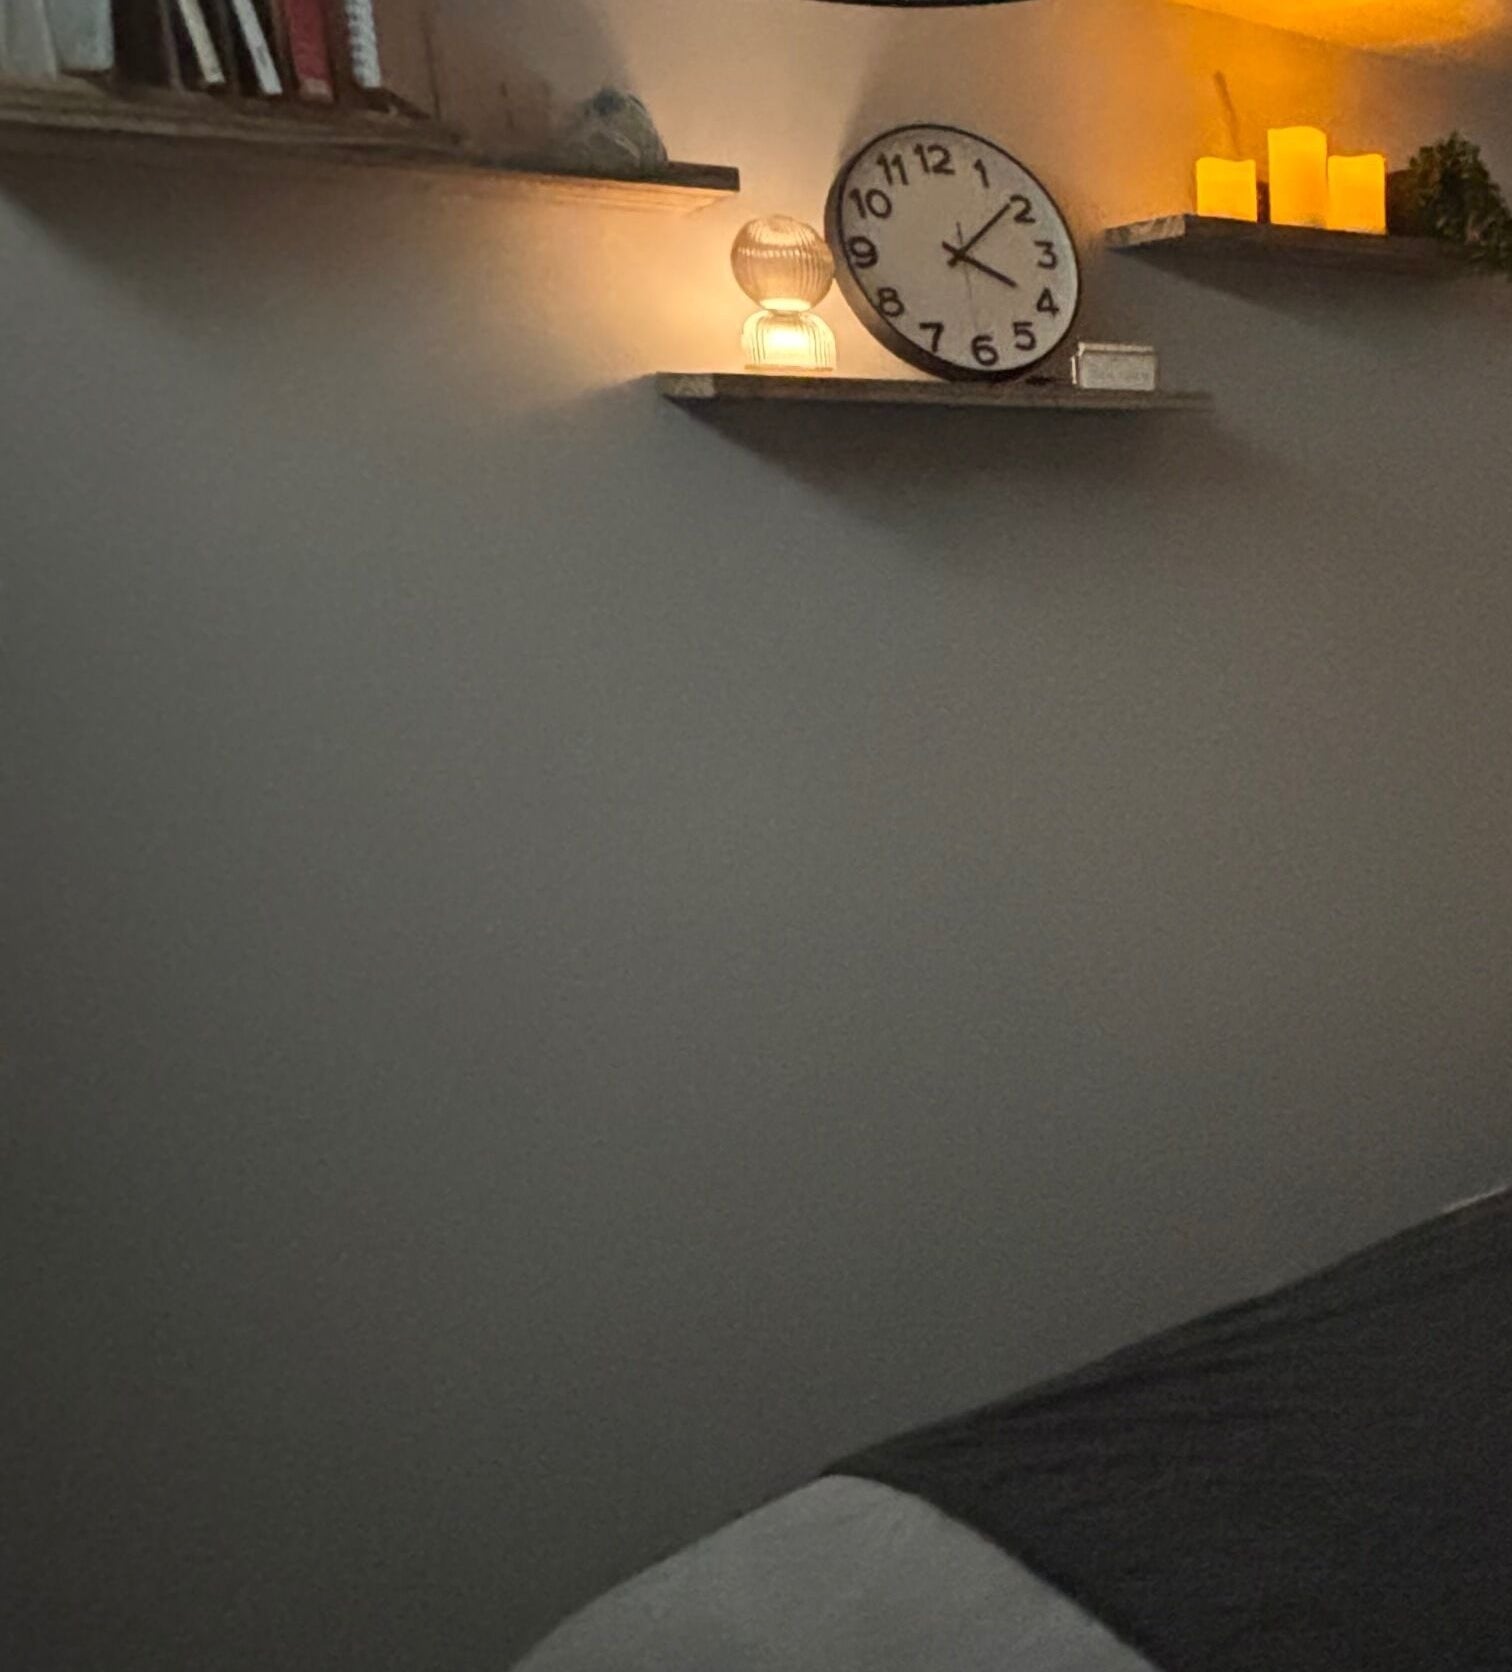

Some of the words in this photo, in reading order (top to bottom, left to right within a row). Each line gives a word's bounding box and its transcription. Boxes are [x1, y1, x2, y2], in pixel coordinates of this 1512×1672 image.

[877, 154, 909, 185] 11
[914, 144, 954, 175] 12
[973, 159, 990, 188] 1
[849, 188, 893, 219] 10
[1010, 195, 1035, 223] 2
[848, 236, 879, 268] 9
[1034, 240, 1058, 269] 3
[877, 287, 905, 317] 8
[1036, 288, 1060, 318] 4
[919, 322, 945, 352] 7
[971, 335, 999, 366] 6
[1013, 321, 1037, 351] 5
